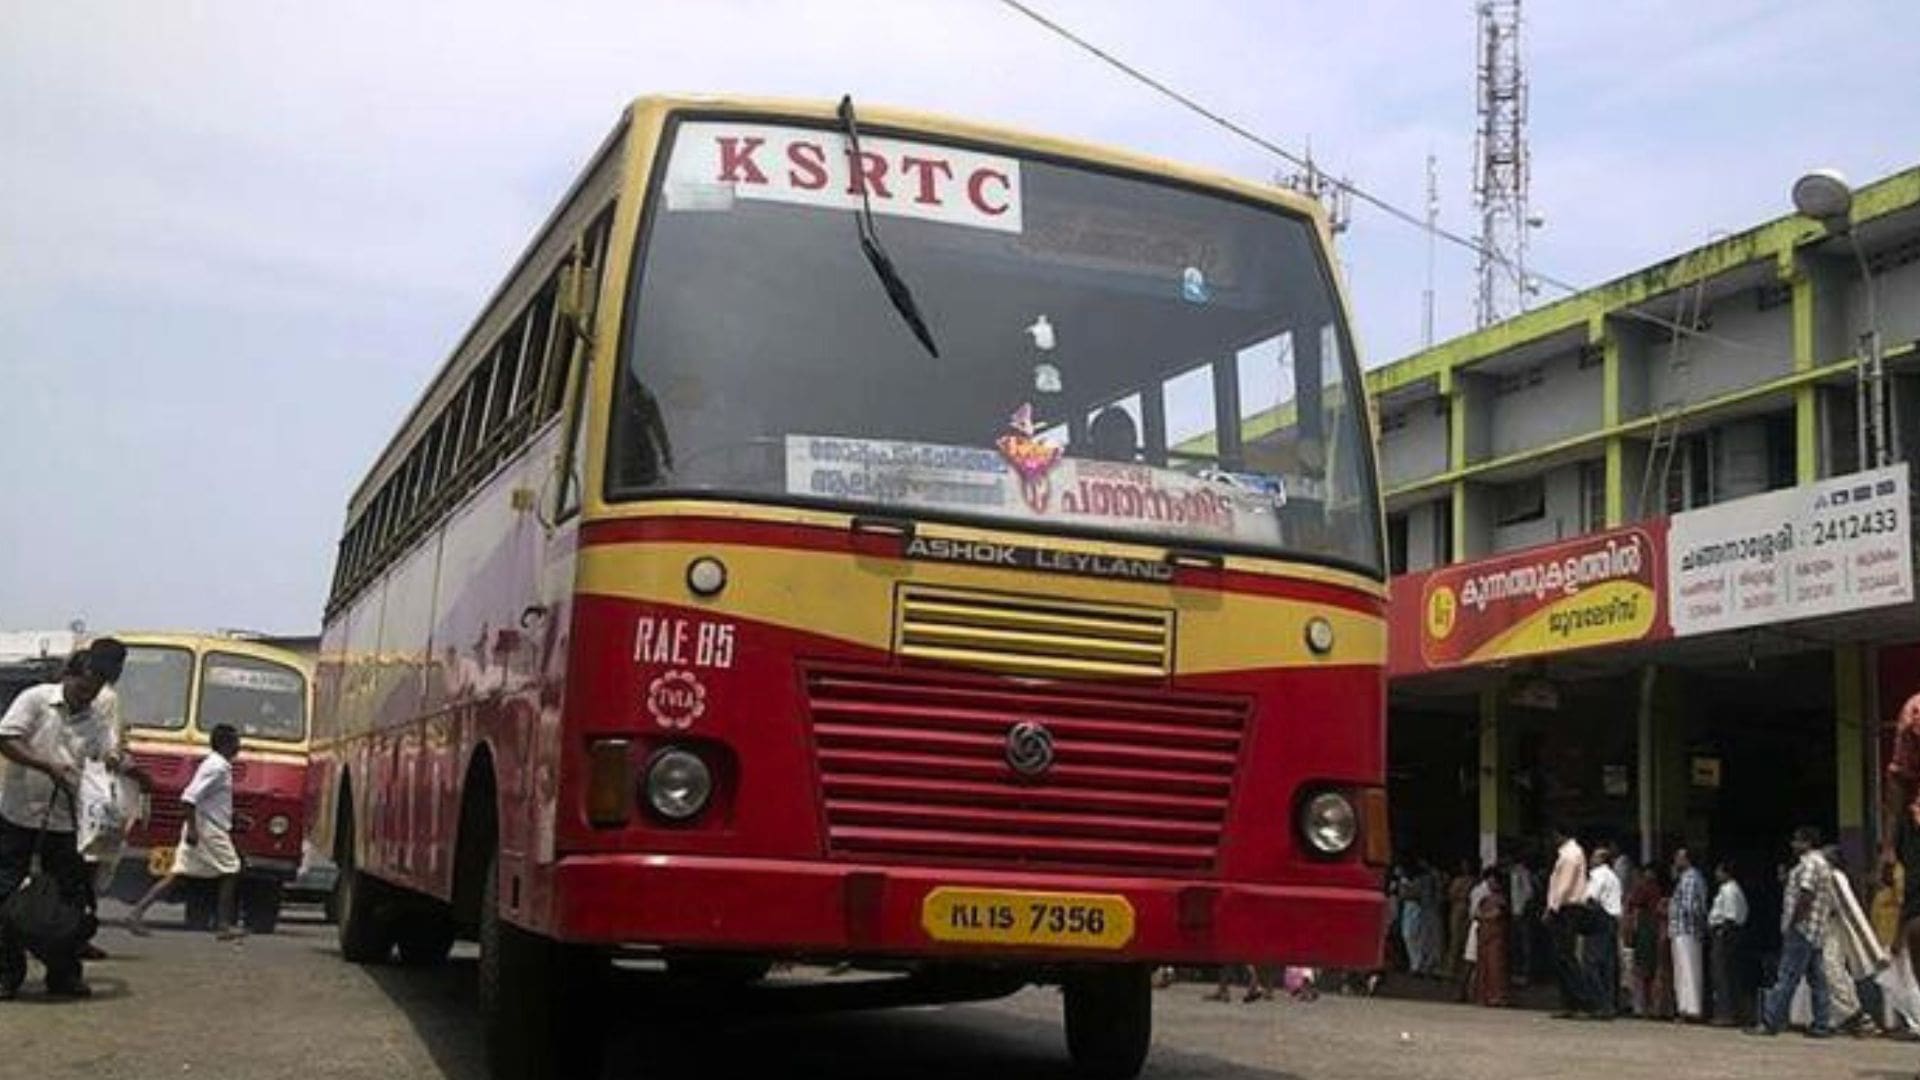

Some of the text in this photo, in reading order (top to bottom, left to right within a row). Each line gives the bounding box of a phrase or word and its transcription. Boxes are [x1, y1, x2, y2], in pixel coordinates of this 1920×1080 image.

[715, 137, 1011, 216] KSRTC
[1814, 509, 1897, 546] 2412433
[907, 538, 1174, 579] ASHOK LEYLAND
[633, 617, 689, 665] RAE
[1029, 904, 1105, 934] 7356
